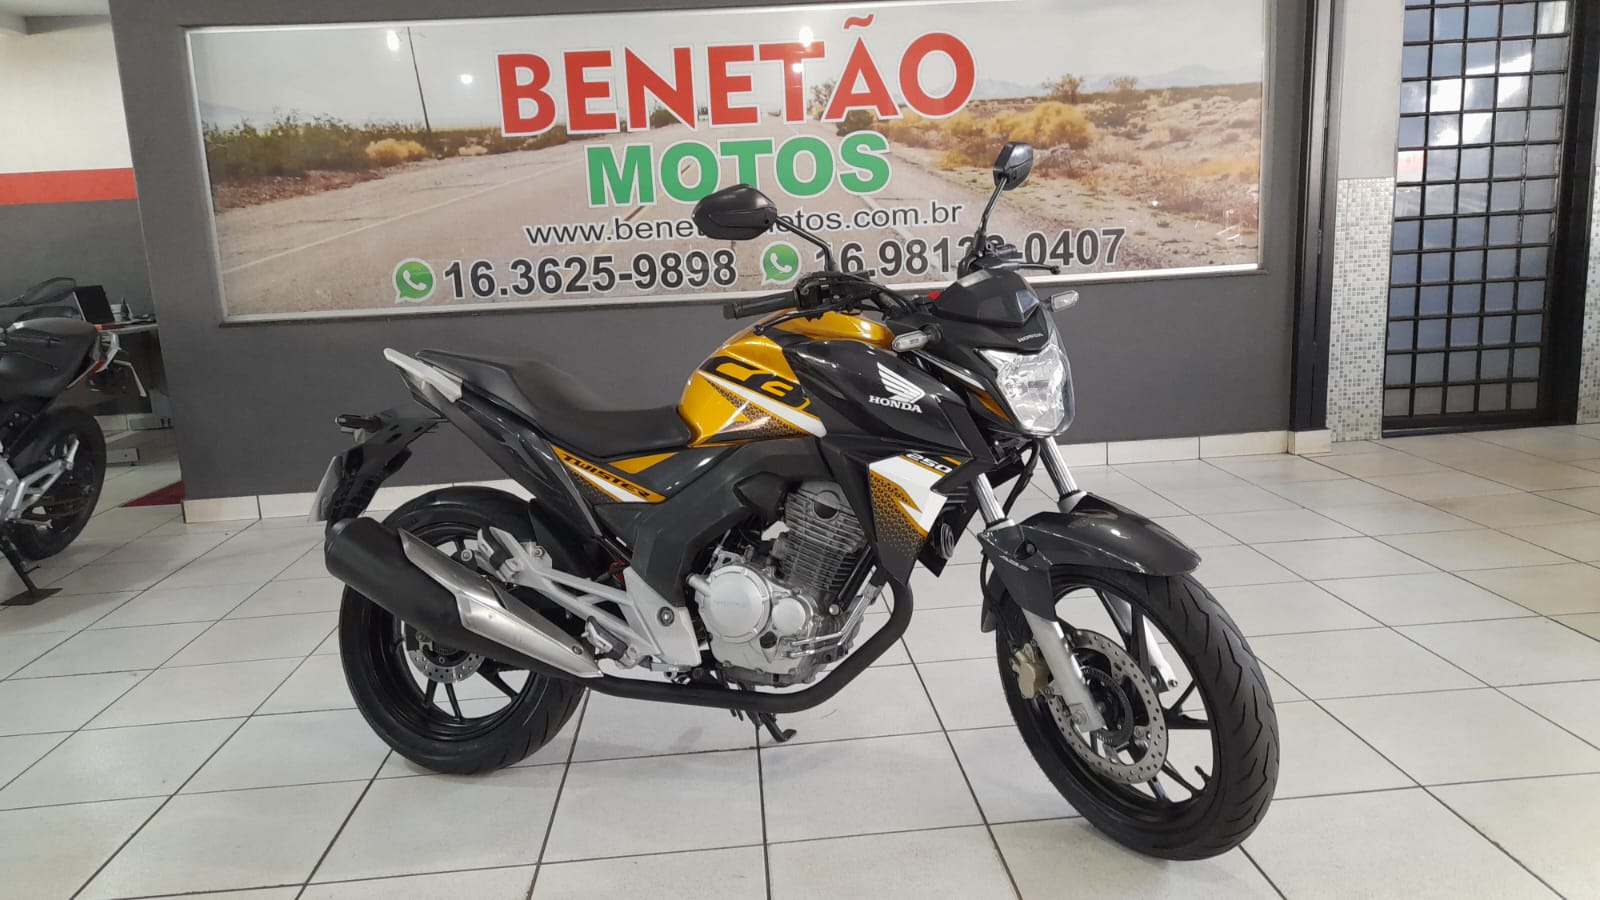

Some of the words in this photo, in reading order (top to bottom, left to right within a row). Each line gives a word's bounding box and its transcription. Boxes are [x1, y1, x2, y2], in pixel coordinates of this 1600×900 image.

[498, 14, 975, 134] BENETÃO
[587, 133, 890, 206] MOTOS
[445, 250, 736, 298] 16.3625-9898
[1016, 333, 1044, 343] HONDA
[869, 395, 923, 413] HONDA
[561, 453, 650, 498] TWISTER
[906, 452, 953, 474] 250
